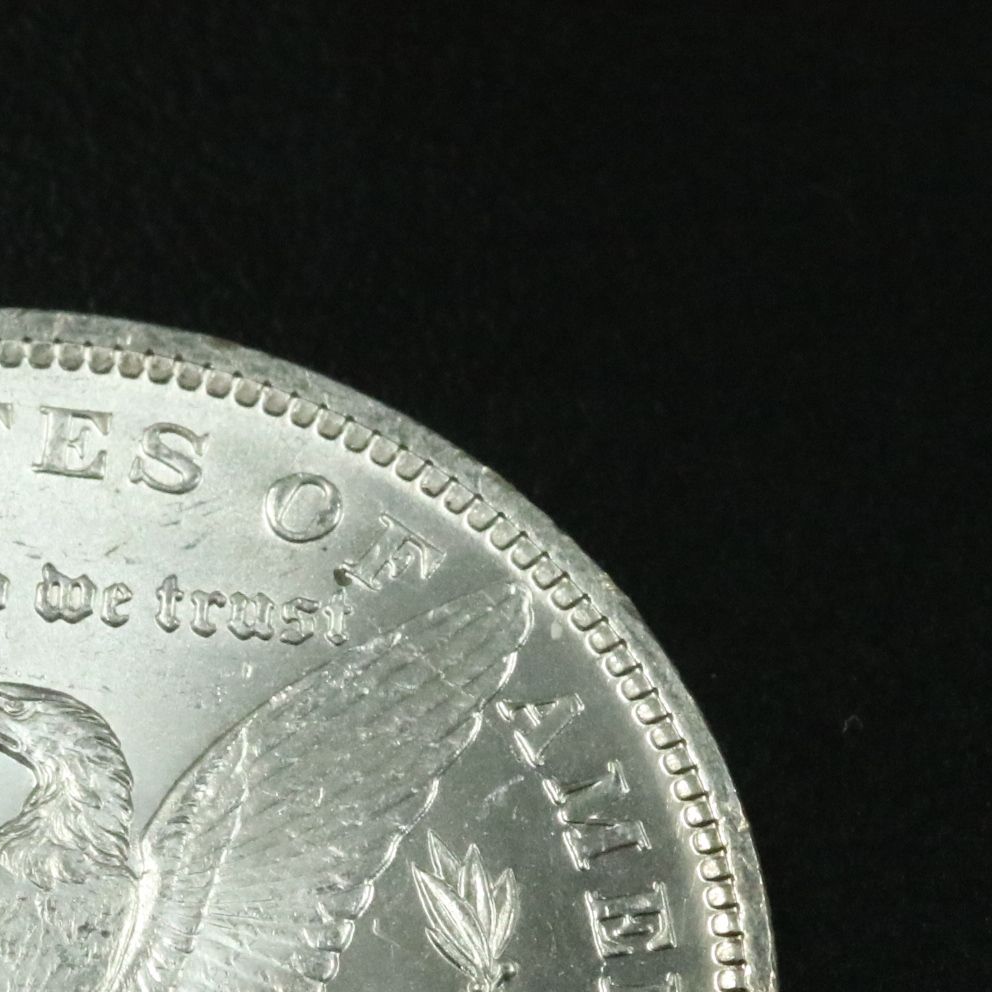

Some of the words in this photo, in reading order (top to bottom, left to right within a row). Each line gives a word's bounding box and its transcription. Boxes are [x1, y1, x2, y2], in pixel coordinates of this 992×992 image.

[262, 471, 448, 592] OF
[33, 561, 132, 629] we
[154, 574, 352, 648] trust
